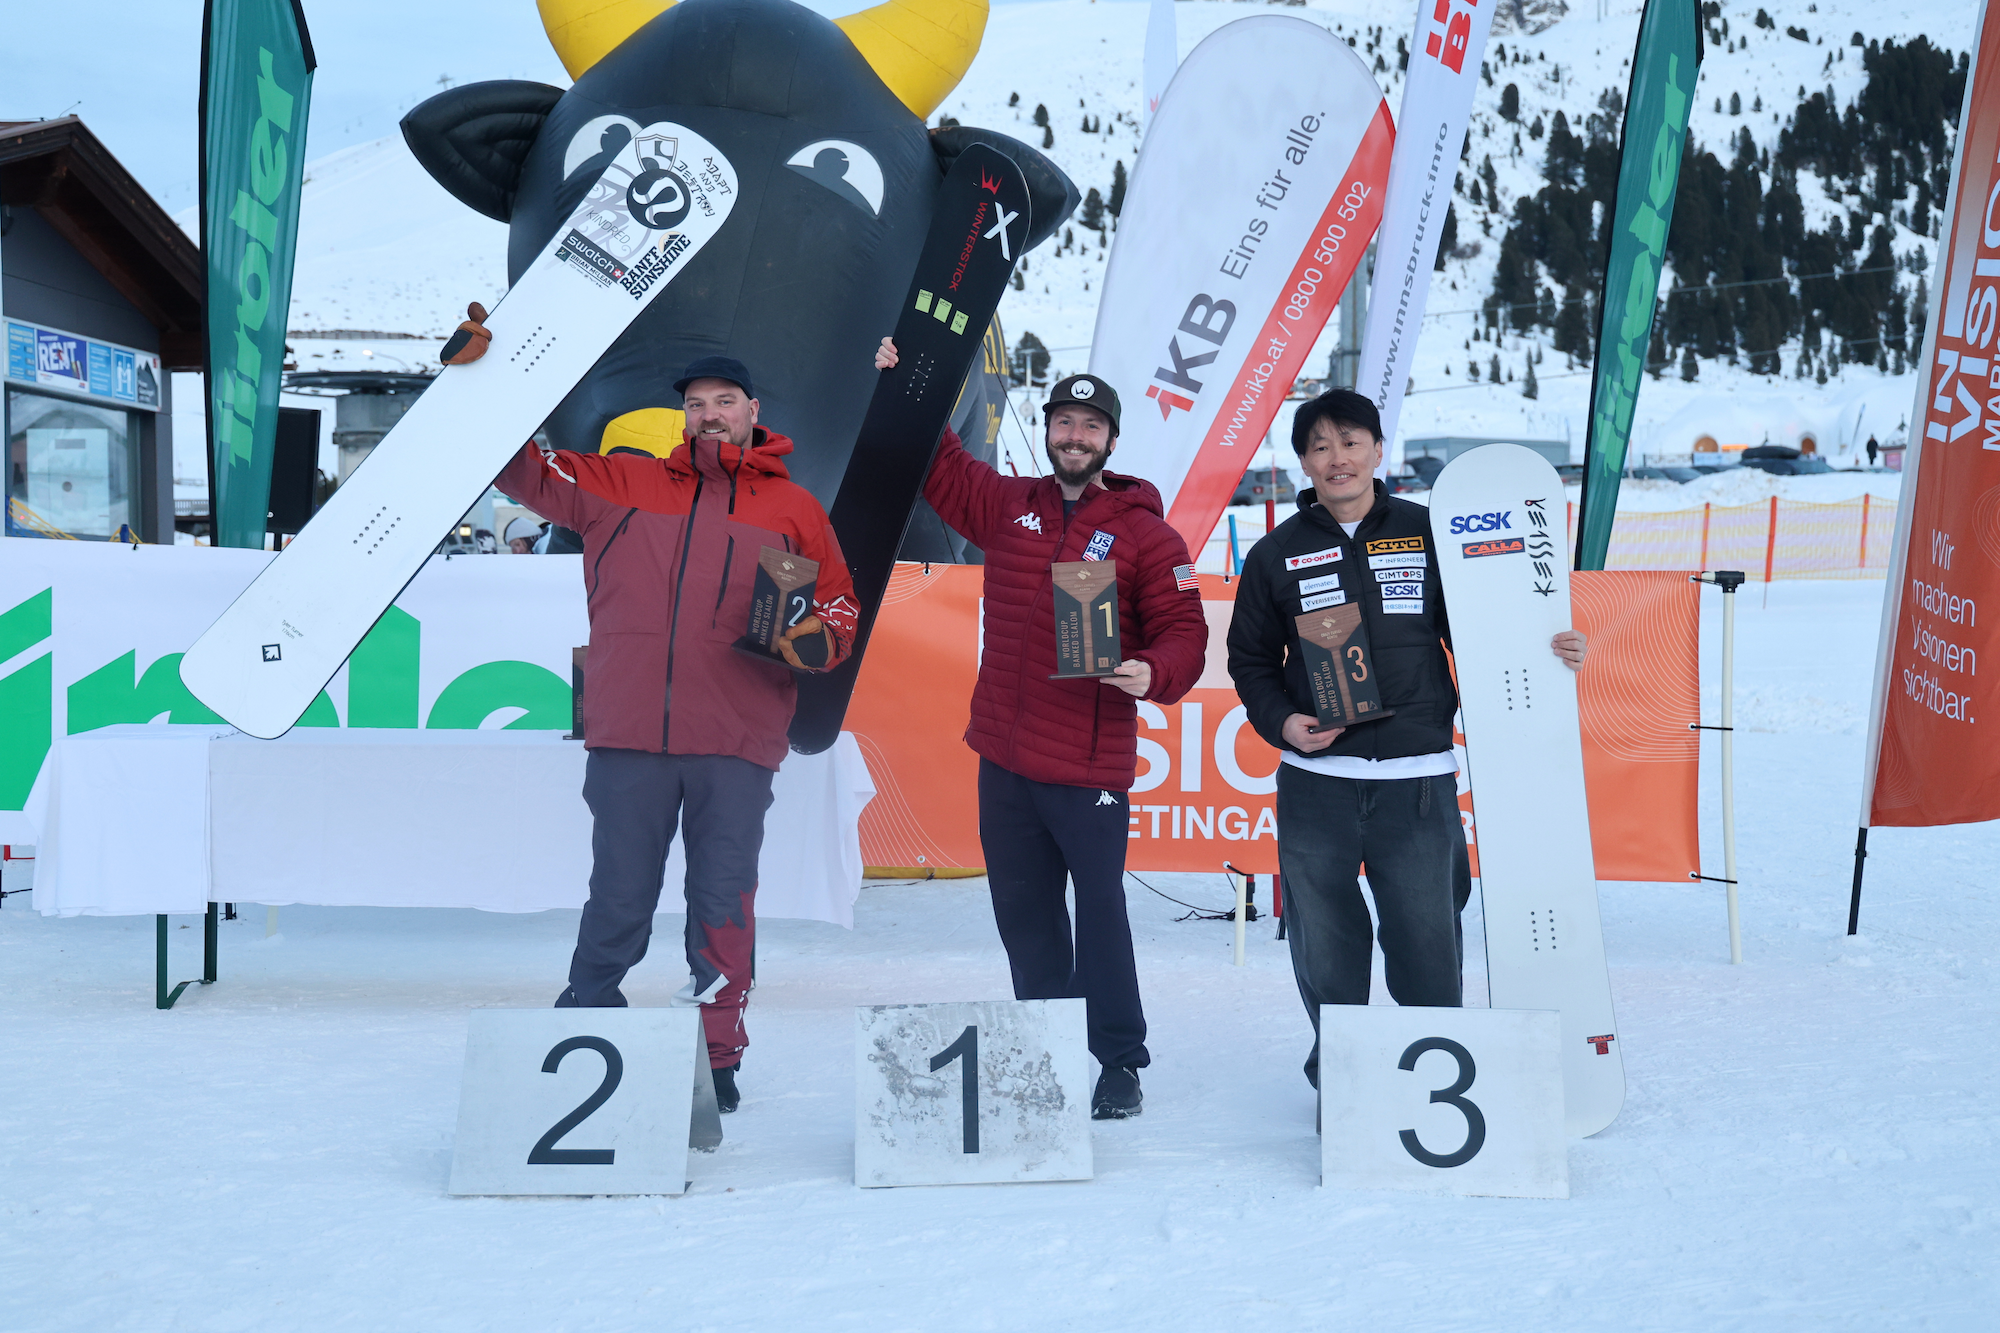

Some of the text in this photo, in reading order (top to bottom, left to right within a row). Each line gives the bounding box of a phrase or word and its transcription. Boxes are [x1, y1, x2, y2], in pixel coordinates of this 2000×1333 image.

[699, 172, 715, 192] AND
[703, 156, 732, 195] ADAPT
[1219, 110, 1326, 280] Eins für alle.
[586, 210, 631, 245] KINDRED
[949, 202, 988, 292] WINTERSTICK
[983, 201, 1020, 262] X
[567, 235, 615, 274] swatch
[570, 253, 590, 270] BRIAN
[619, 246, 661, 292] BANFF
[629, 234, 692, 300] SUNSHINE
[1375, 121, 1447, 411] www.innsbruck.info
[1219, 337, 1288, 447] www.ikb.at
[1283, 267, 1323, 320] 0800
[1314, 223, 1347, 265] 500
[1336, 180, 1371, 222] 502
[38, 341, 77, 371] RENT
[1092, 535, 1110, 548] US
[1095, 530, 1114, 541] TOYOTA
[1450, 510, 1512, 535] SCSK
[1369, 539, 1422, 552] KITO
[1385, 556, 1424, 564] INFRONEER
[1464, 541, 1523, 556] CALLA
[1932, 528, 1955, 571] Wir
[1304, 580, 1334, 591] elematec
[1377, 570, 1422, 580] CIMTOPS
[1384, 584, 1419, 596] SCSK
[751, 598, 764, 634] WORLDCUP
[758, 594, 773, 646] BANKED SLALOM
[788, 595, 807, 627] 2
[1098, 602, 1113, 637] 1
[1311, 595, 1341, 606] VERISERVE
[1912, 578, 1976, 627] machen
[1061, 620, 1070, 659] WORLDCUP
[1070, 611, 1081, 668] BANKED SLALOM
[1346, 645, 1368, 682] 3
[1313, 671, 1328, 711] WORLDCUP
[1320, 660, 1341, 718] BANKED SLALOM
[1903, 663, 1975, 724] sichtbar.
[526, 1035, 624, 1165] 2
[929, 1025, 980, 1155] 1
[1397, 1036, 1486, 1168] 3
